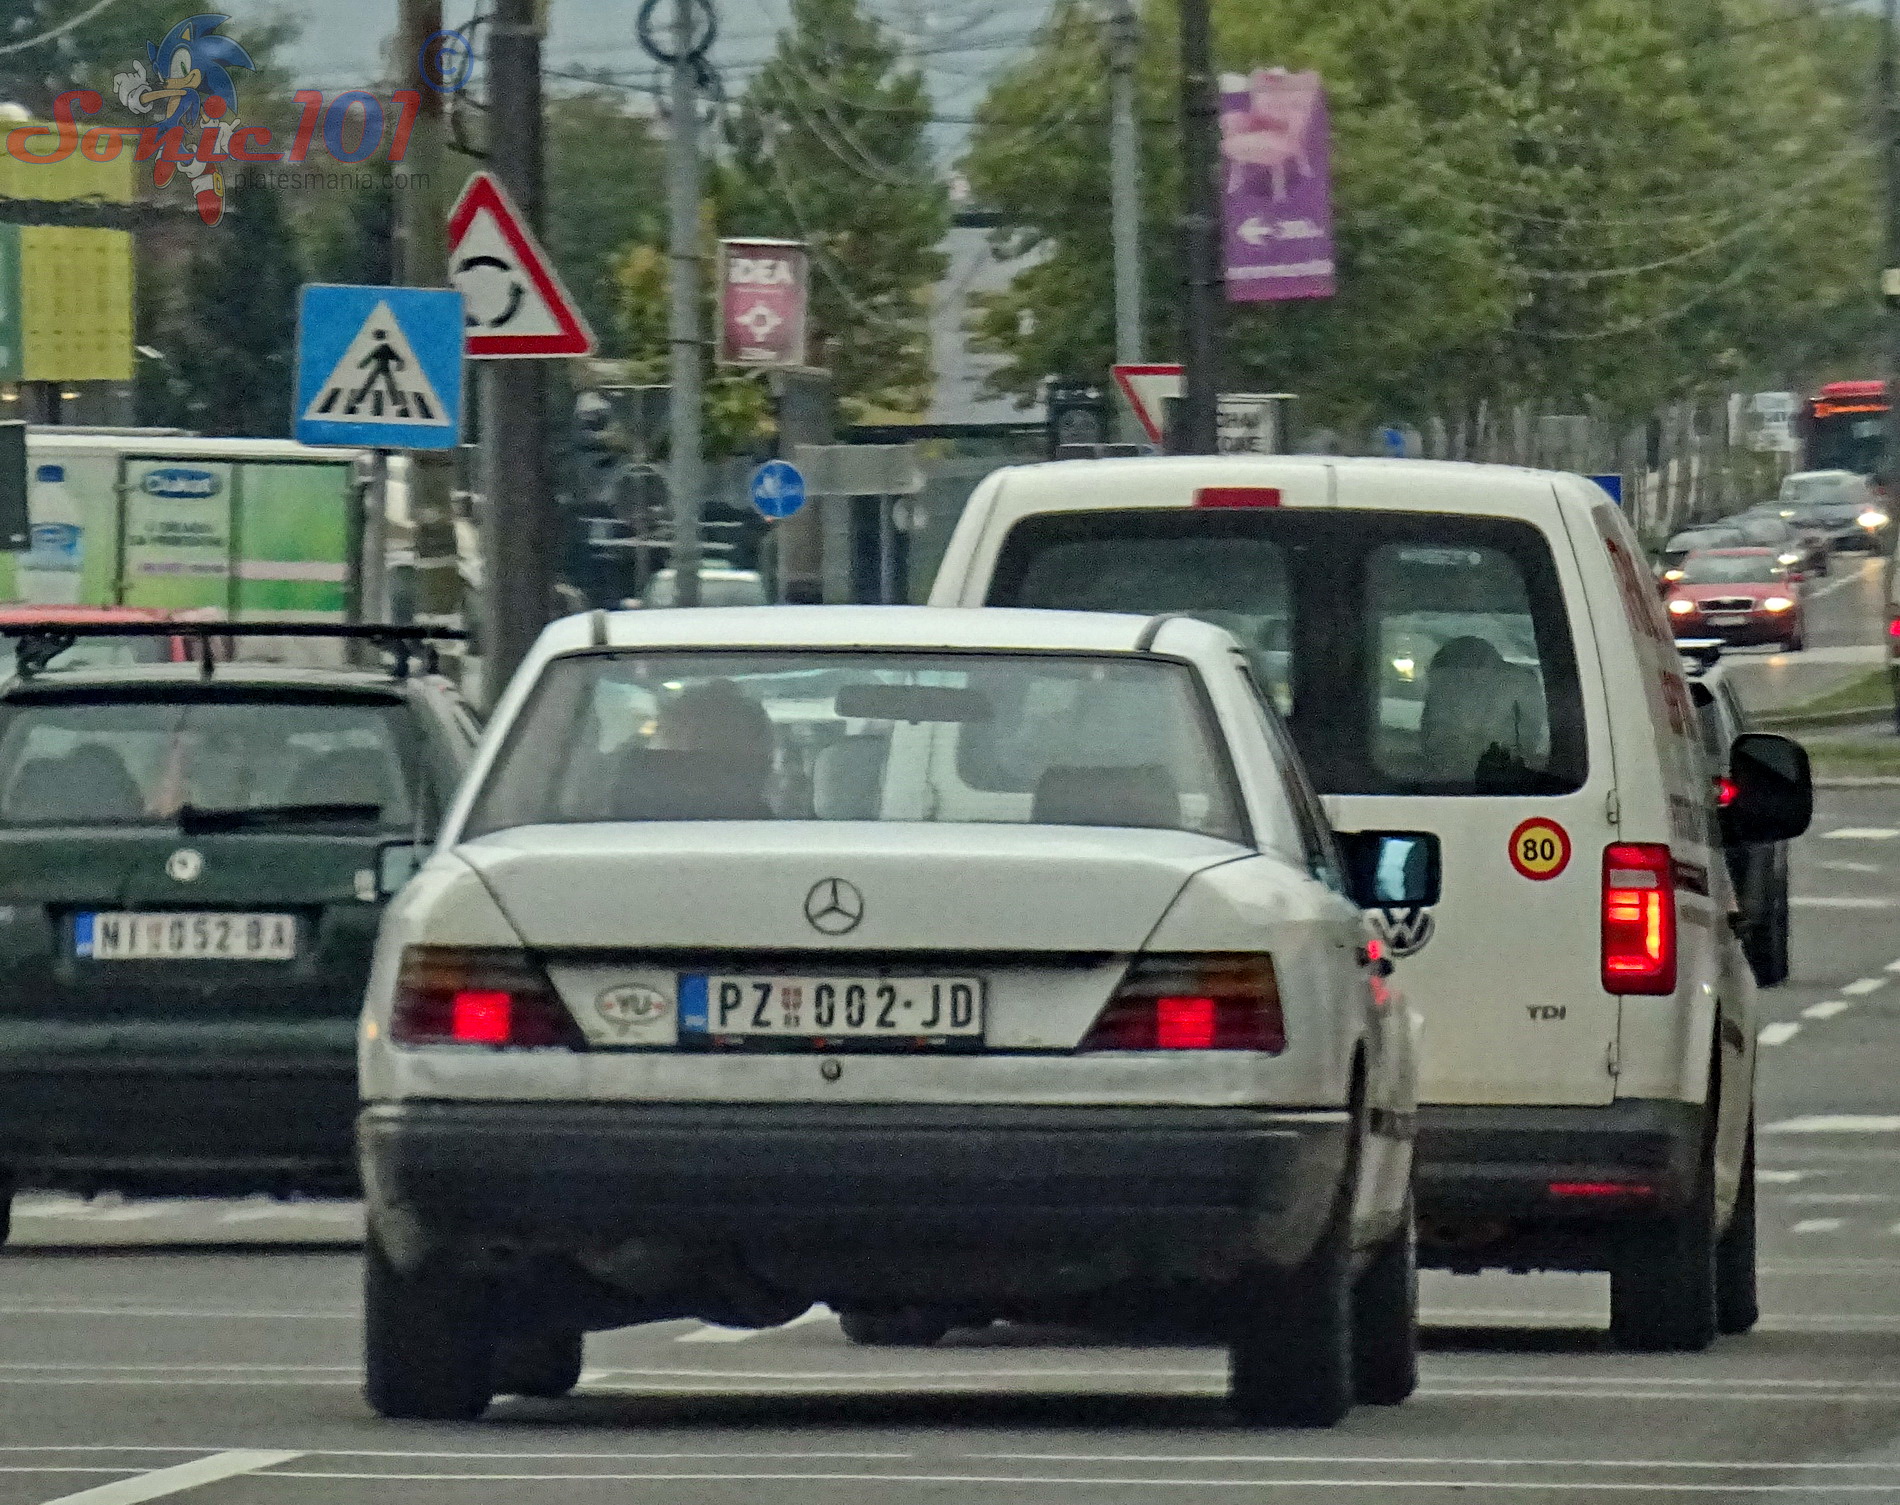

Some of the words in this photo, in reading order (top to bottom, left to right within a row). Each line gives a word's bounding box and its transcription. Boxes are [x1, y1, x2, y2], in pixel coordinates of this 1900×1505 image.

[730, 258, 794, 284] IDEA
[1523, 838, 1555, 861] 80
[719, 981, 773, 1027] PZ
[1526, 1004, 1567, 1020] TDI
